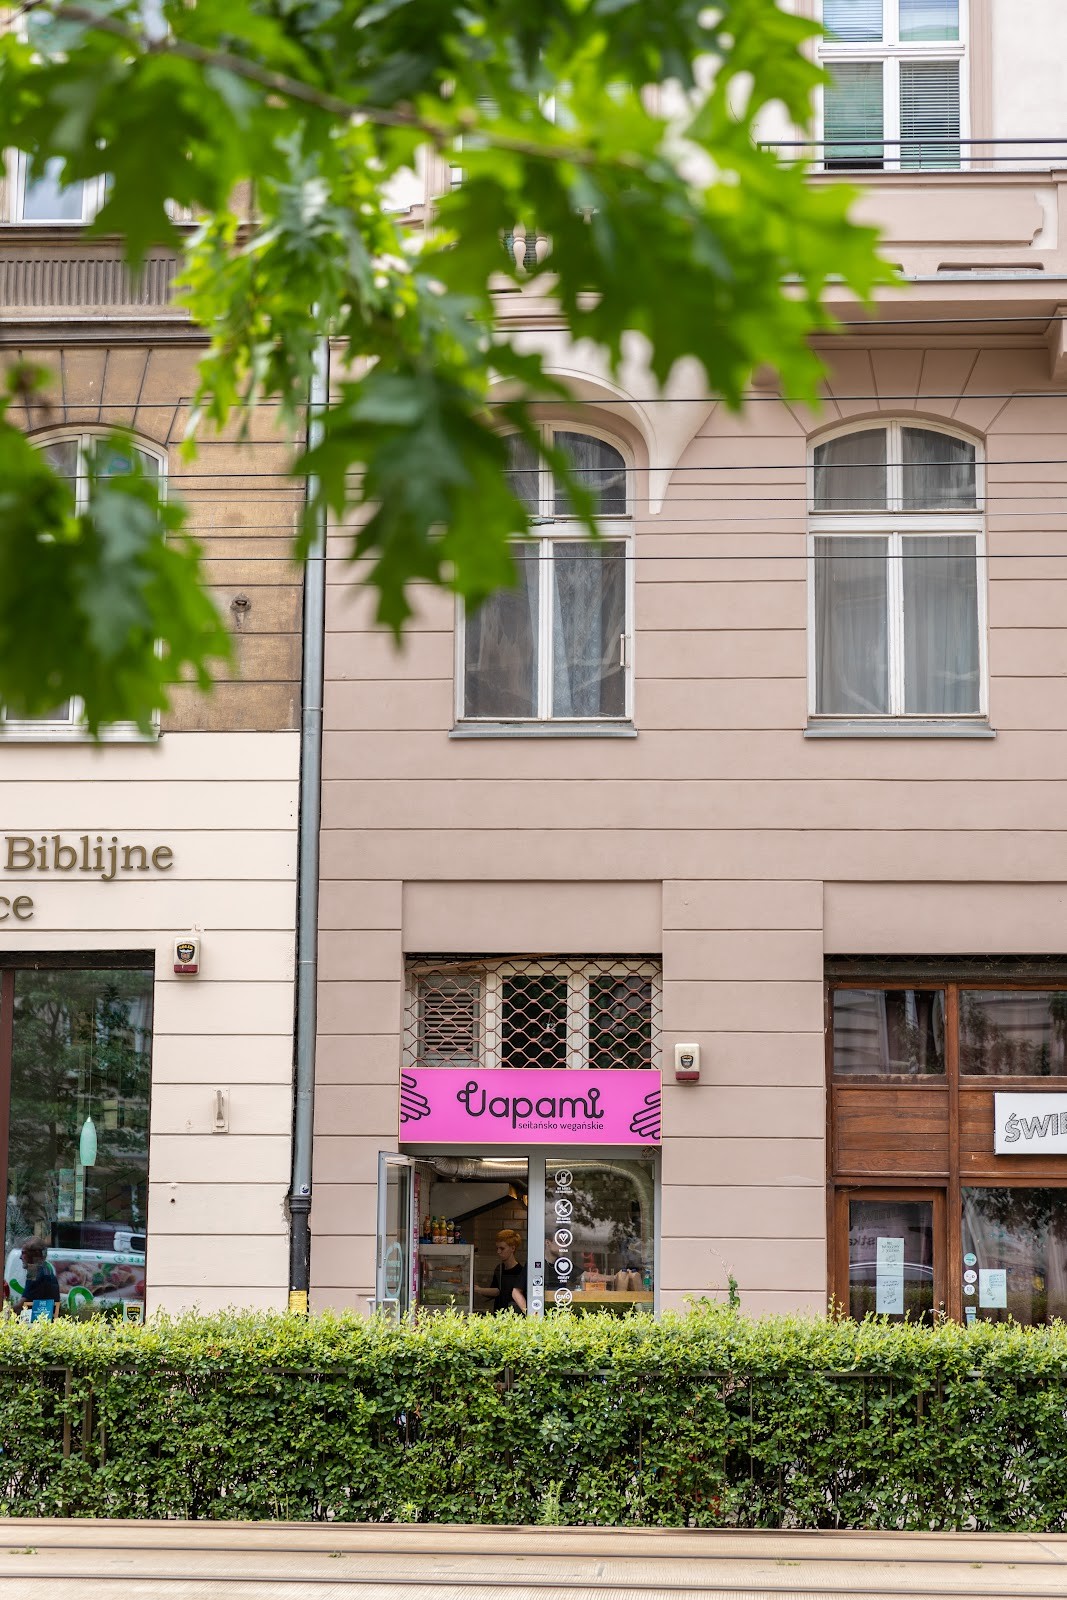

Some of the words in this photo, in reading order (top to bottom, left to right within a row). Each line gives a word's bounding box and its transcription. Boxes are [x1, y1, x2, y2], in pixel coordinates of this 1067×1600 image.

[4, 835, 174, 882] Biblijne
[518, 1120, 558, 1130] seitańsko
[560, 1120, 604, 1131] wegańskie
